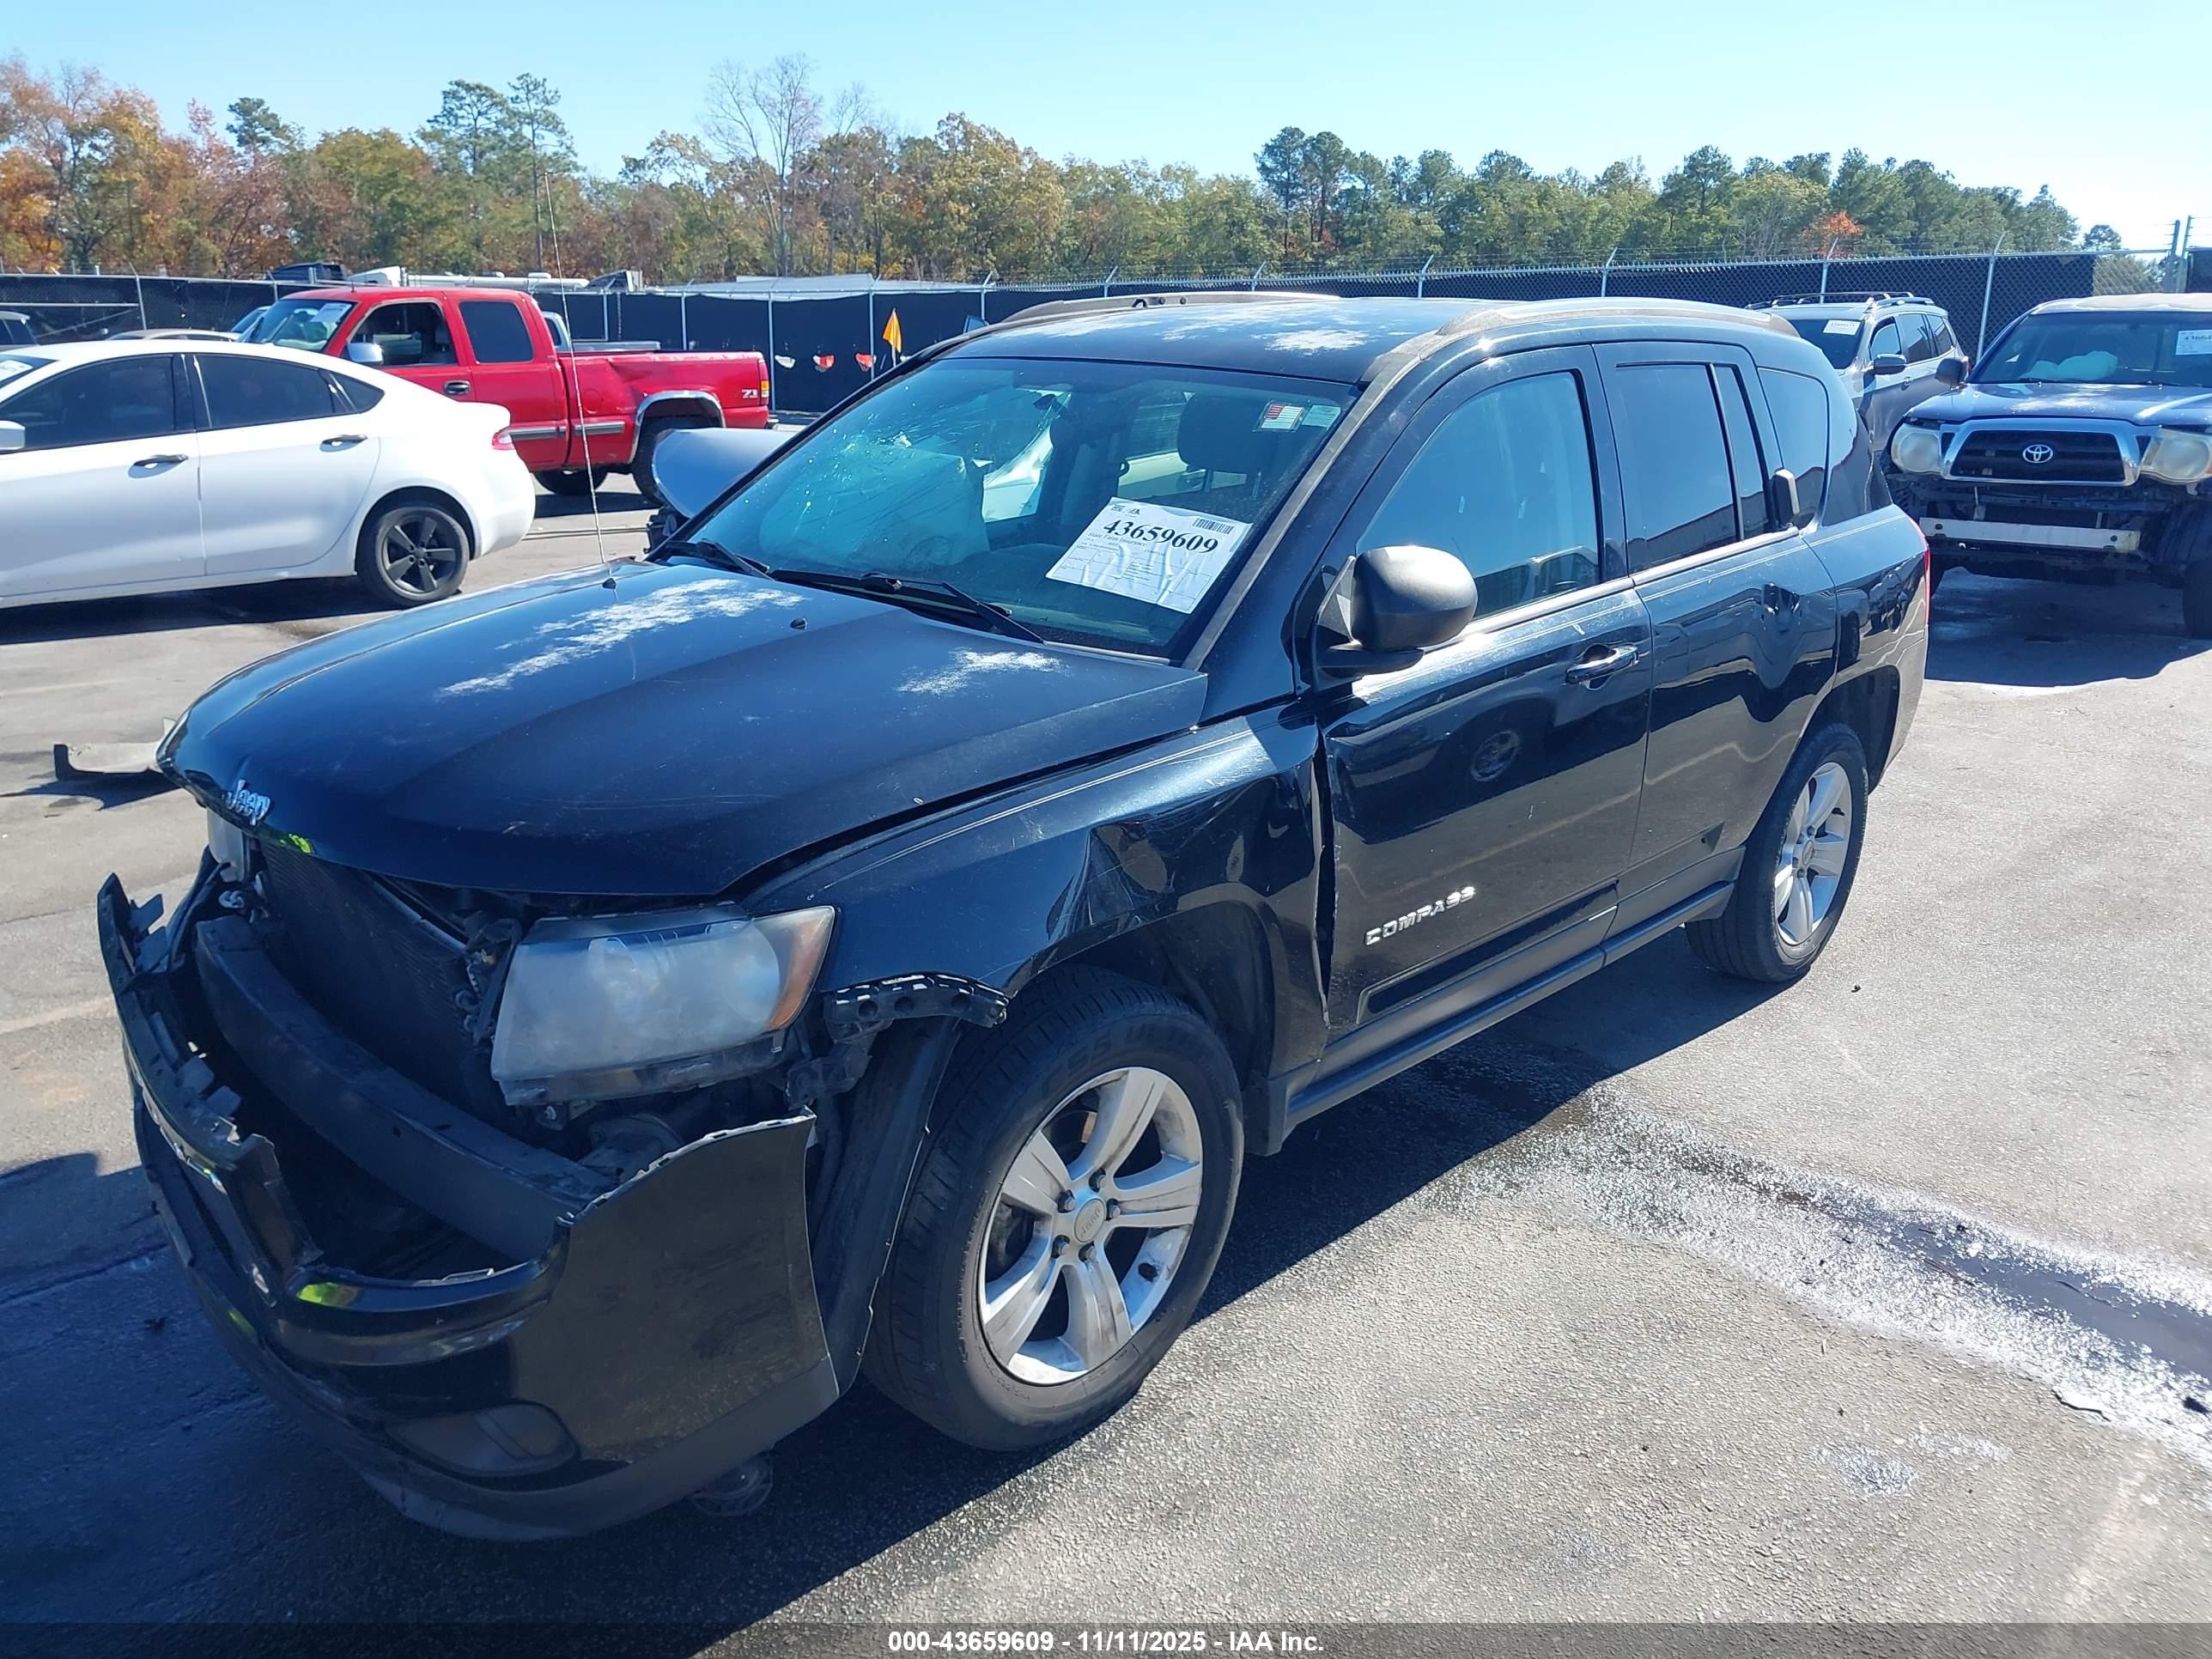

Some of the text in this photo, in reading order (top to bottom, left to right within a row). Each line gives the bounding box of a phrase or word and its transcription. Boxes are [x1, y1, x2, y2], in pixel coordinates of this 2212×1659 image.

[1103, 520, 1218, 554] 43659609
[226, 779, 271, 825] Jeep
[1365, 885, 1475, 945] COMPASS
